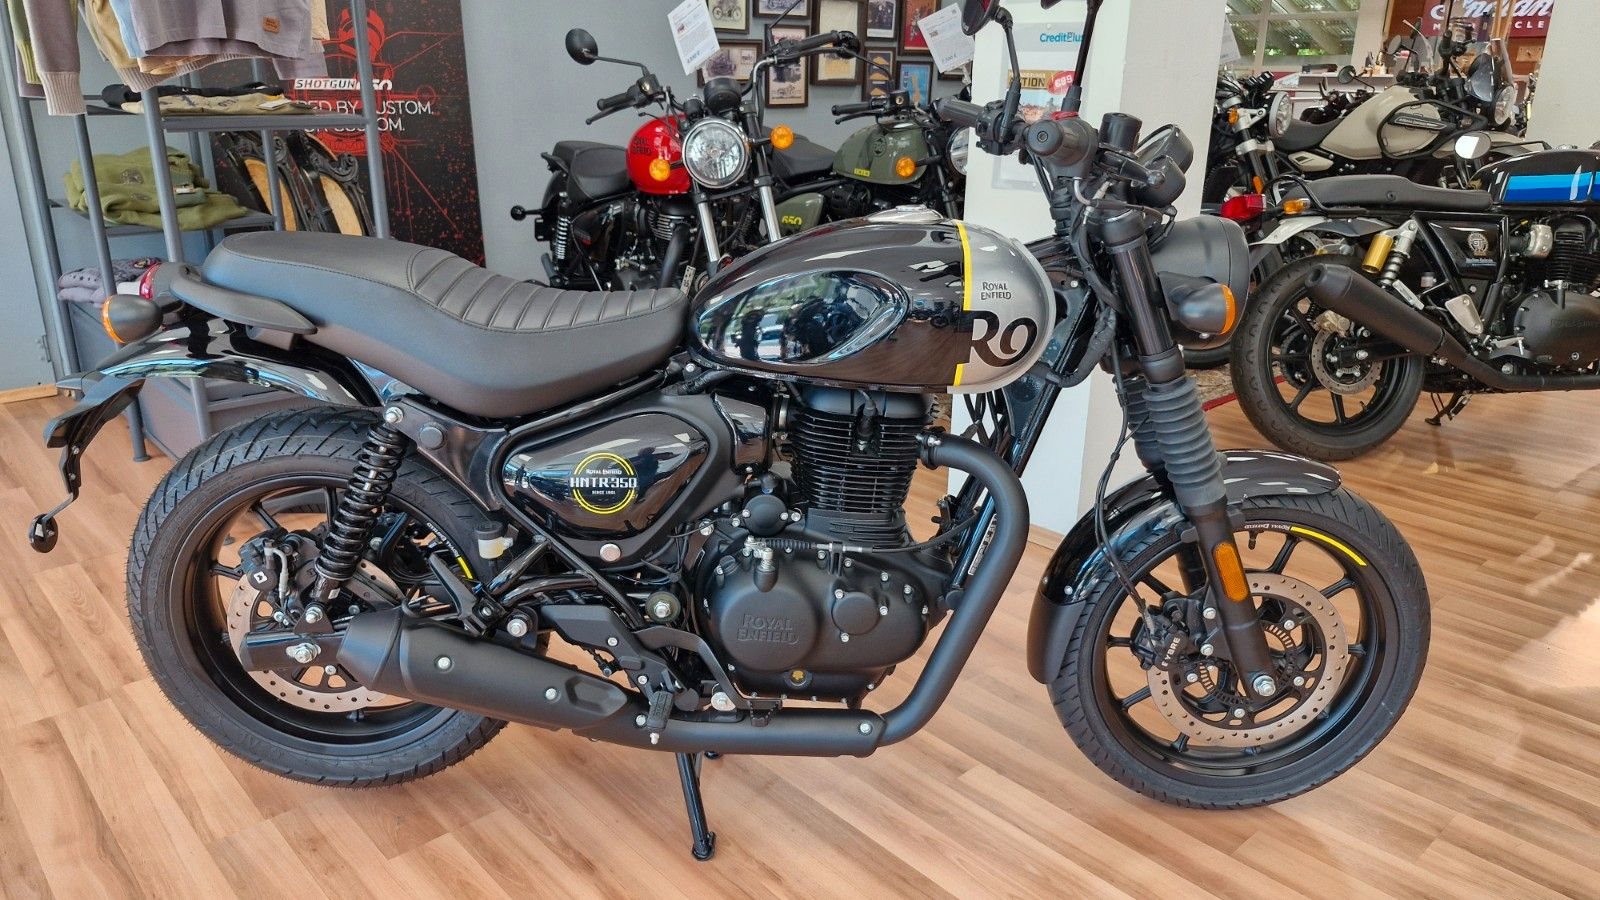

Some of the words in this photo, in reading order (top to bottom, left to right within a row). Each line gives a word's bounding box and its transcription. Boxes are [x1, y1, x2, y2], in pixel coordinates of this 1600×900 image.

[295, 79, 356, 89] SHOTGUN
[337, 100, 358, 114] BY
[375, 100, 434, 115] USTOM.
[982, 282, 1007, 291] ROYAL
[981, 291, 1011, 300] ENFIELD
[742, 613, 793, 630] ROYAL
[737, 628, 799, 645] ENFIELD
